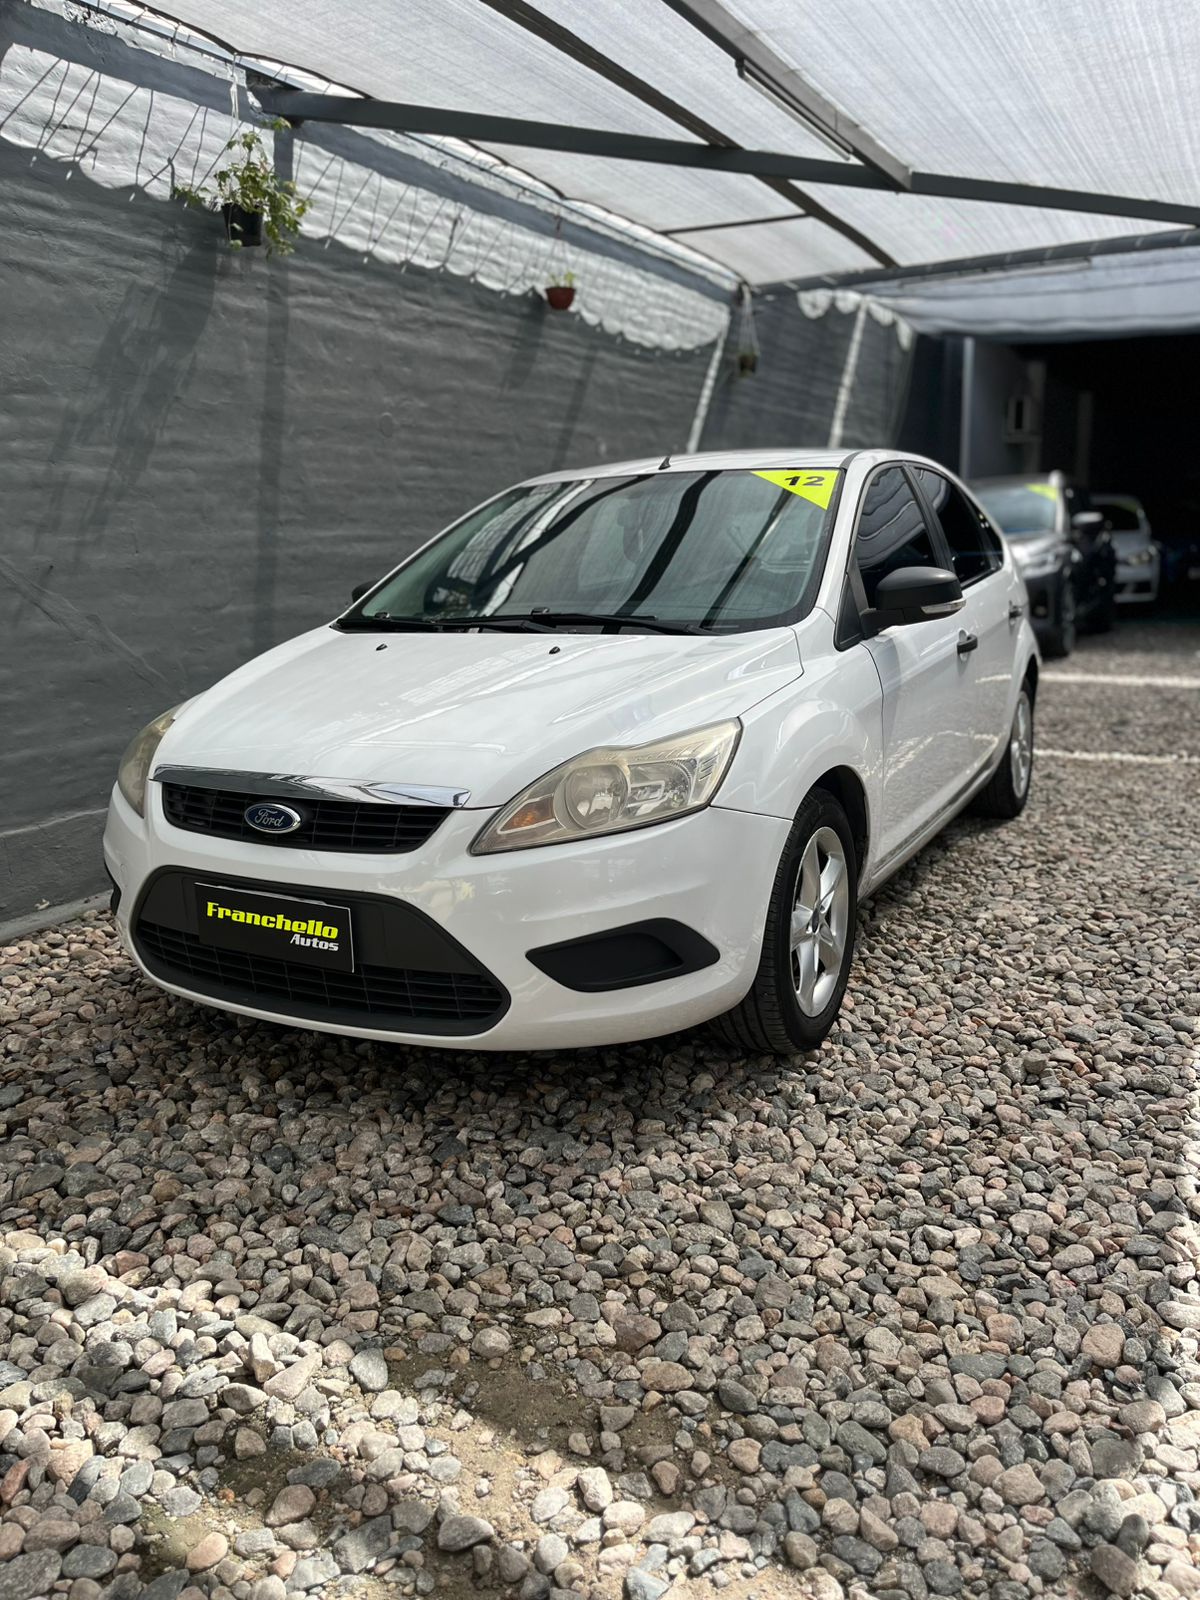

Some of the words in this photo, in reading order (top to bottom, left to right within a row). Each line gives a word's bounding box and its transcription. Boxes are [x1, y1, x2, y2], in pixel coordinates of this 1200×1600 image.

[784, 475, 825, 486] 12
[255, 809, 284, 827] Ford
[206, 901, 338, 939] Franchello
[290, 934, 339, 951] Autos
